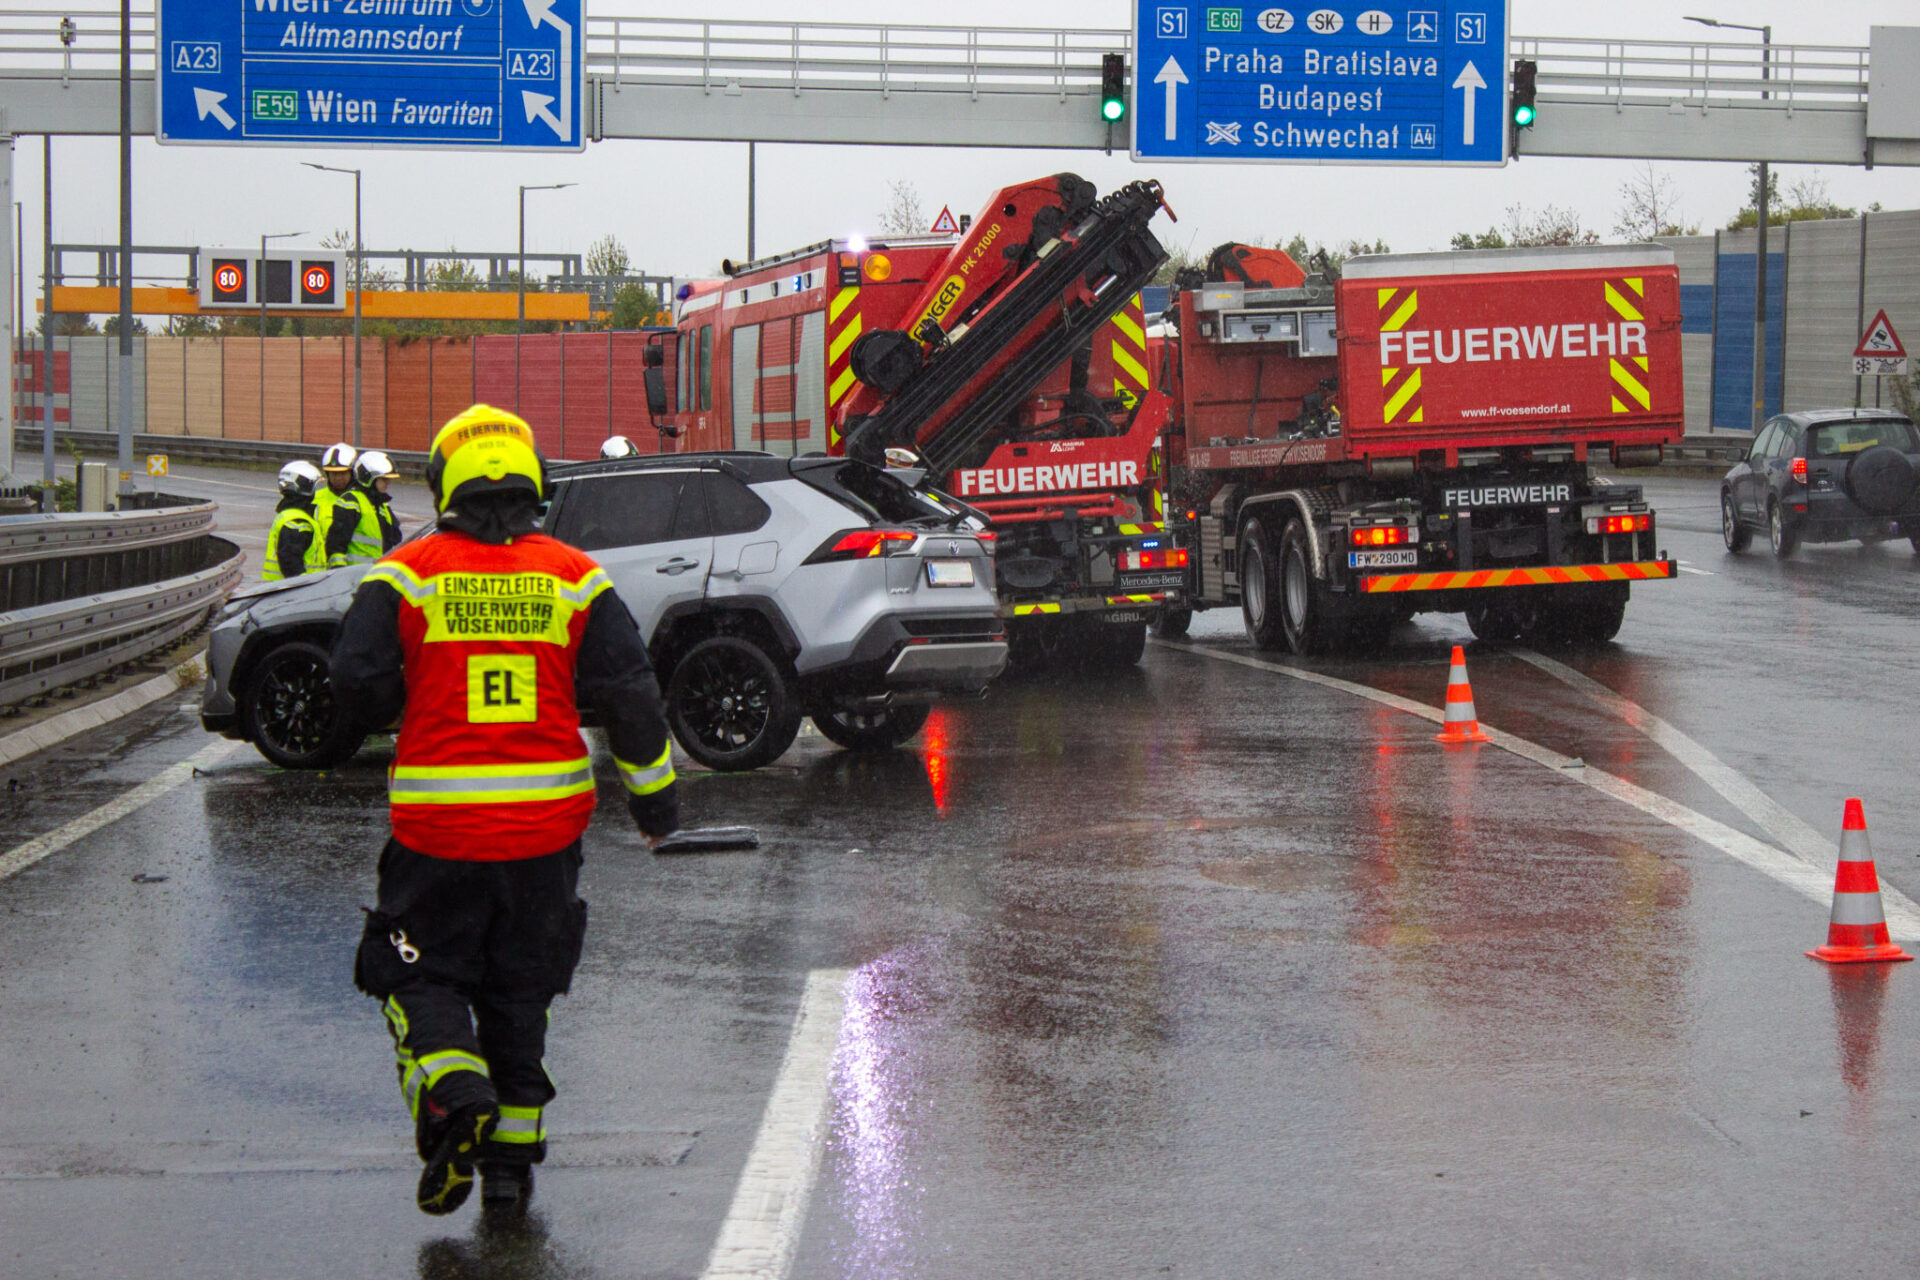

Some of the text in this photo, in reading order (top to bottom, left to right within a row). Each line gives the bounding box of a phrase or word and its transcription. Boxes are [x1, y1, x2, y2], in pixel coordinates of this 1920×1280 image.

[1162, 13, 1183, 34] S1
[1210, 12, 1239, 28] E60
[1265, 13, 1285, 30] CZ
[1314, 14, 1336, 30] SK
[1369, 15, 1380, 31] H
[1460, 18, 1482, 39] S1
[280, 21, 464, 50] Altmannsdorf
[176, 47, 217, 69] A23
[511, 54, 551, 76] A23
[1205, 47, 1437, 76] Praha Bratislava
[255, 95, 294, 116] E59
[307, 90, 493, 126] Wien Favoriten
[1260, 84, 1383, 117] Budapest
[1253, 121, 1399, 149] Schwechat
[1413, 127, 1433, 145] A4
[960, 256, 978, 275] PK
[974, 223, 1001, 257] 21000
[220, 272, 237, 286] 80
[308, 274, 325, 288] 80
[1380, 322, 1648, 365] FEUERWEHR
[1461, 403, 1571, 418] www.ff-voesendorf.at
[961, 460, 1139, 495] FEUERWEHR
[1445, 485, 1570, 506] FEUERWEHR
[1357, 554, 1371, 565] FW
[444, 577, 554, 595] EINSATZLEITER
[1121, 575, 1182, 587] Mercedes-Benz
[444, 602, 553, 619] FEUERWEHR
[1098, 611, 1146, 623] AGIRU
[446, 617, 551, 634] VÖSENDORF
[484, 670, 521, 706] EL
